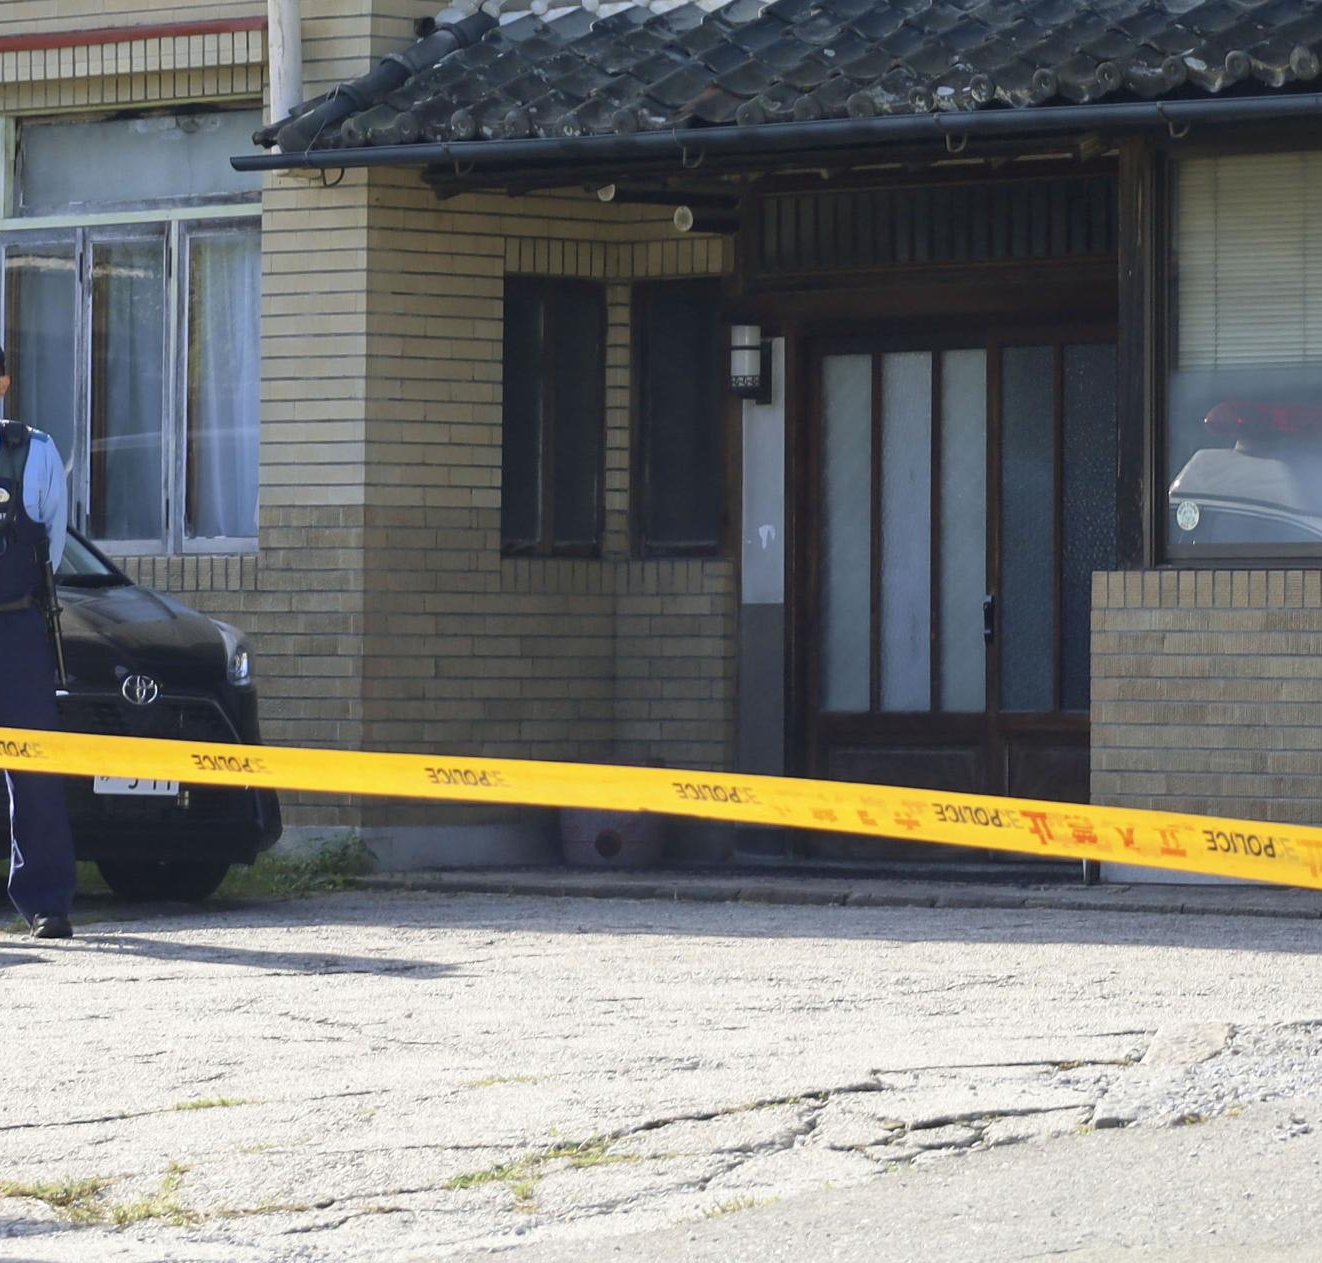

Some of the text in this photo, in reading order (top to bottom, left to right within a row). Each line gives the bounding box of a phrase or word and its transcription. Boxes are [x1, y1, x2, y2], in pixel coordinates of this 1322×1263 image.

[192, 754, 256, 774] POLICE
[425, 767, 492, 788] POLICE
[673, 782, 744, 804] POLICE
[933, 803, 1004, 828] POLICE
[1203, 830, 1276, 859] POLICE
